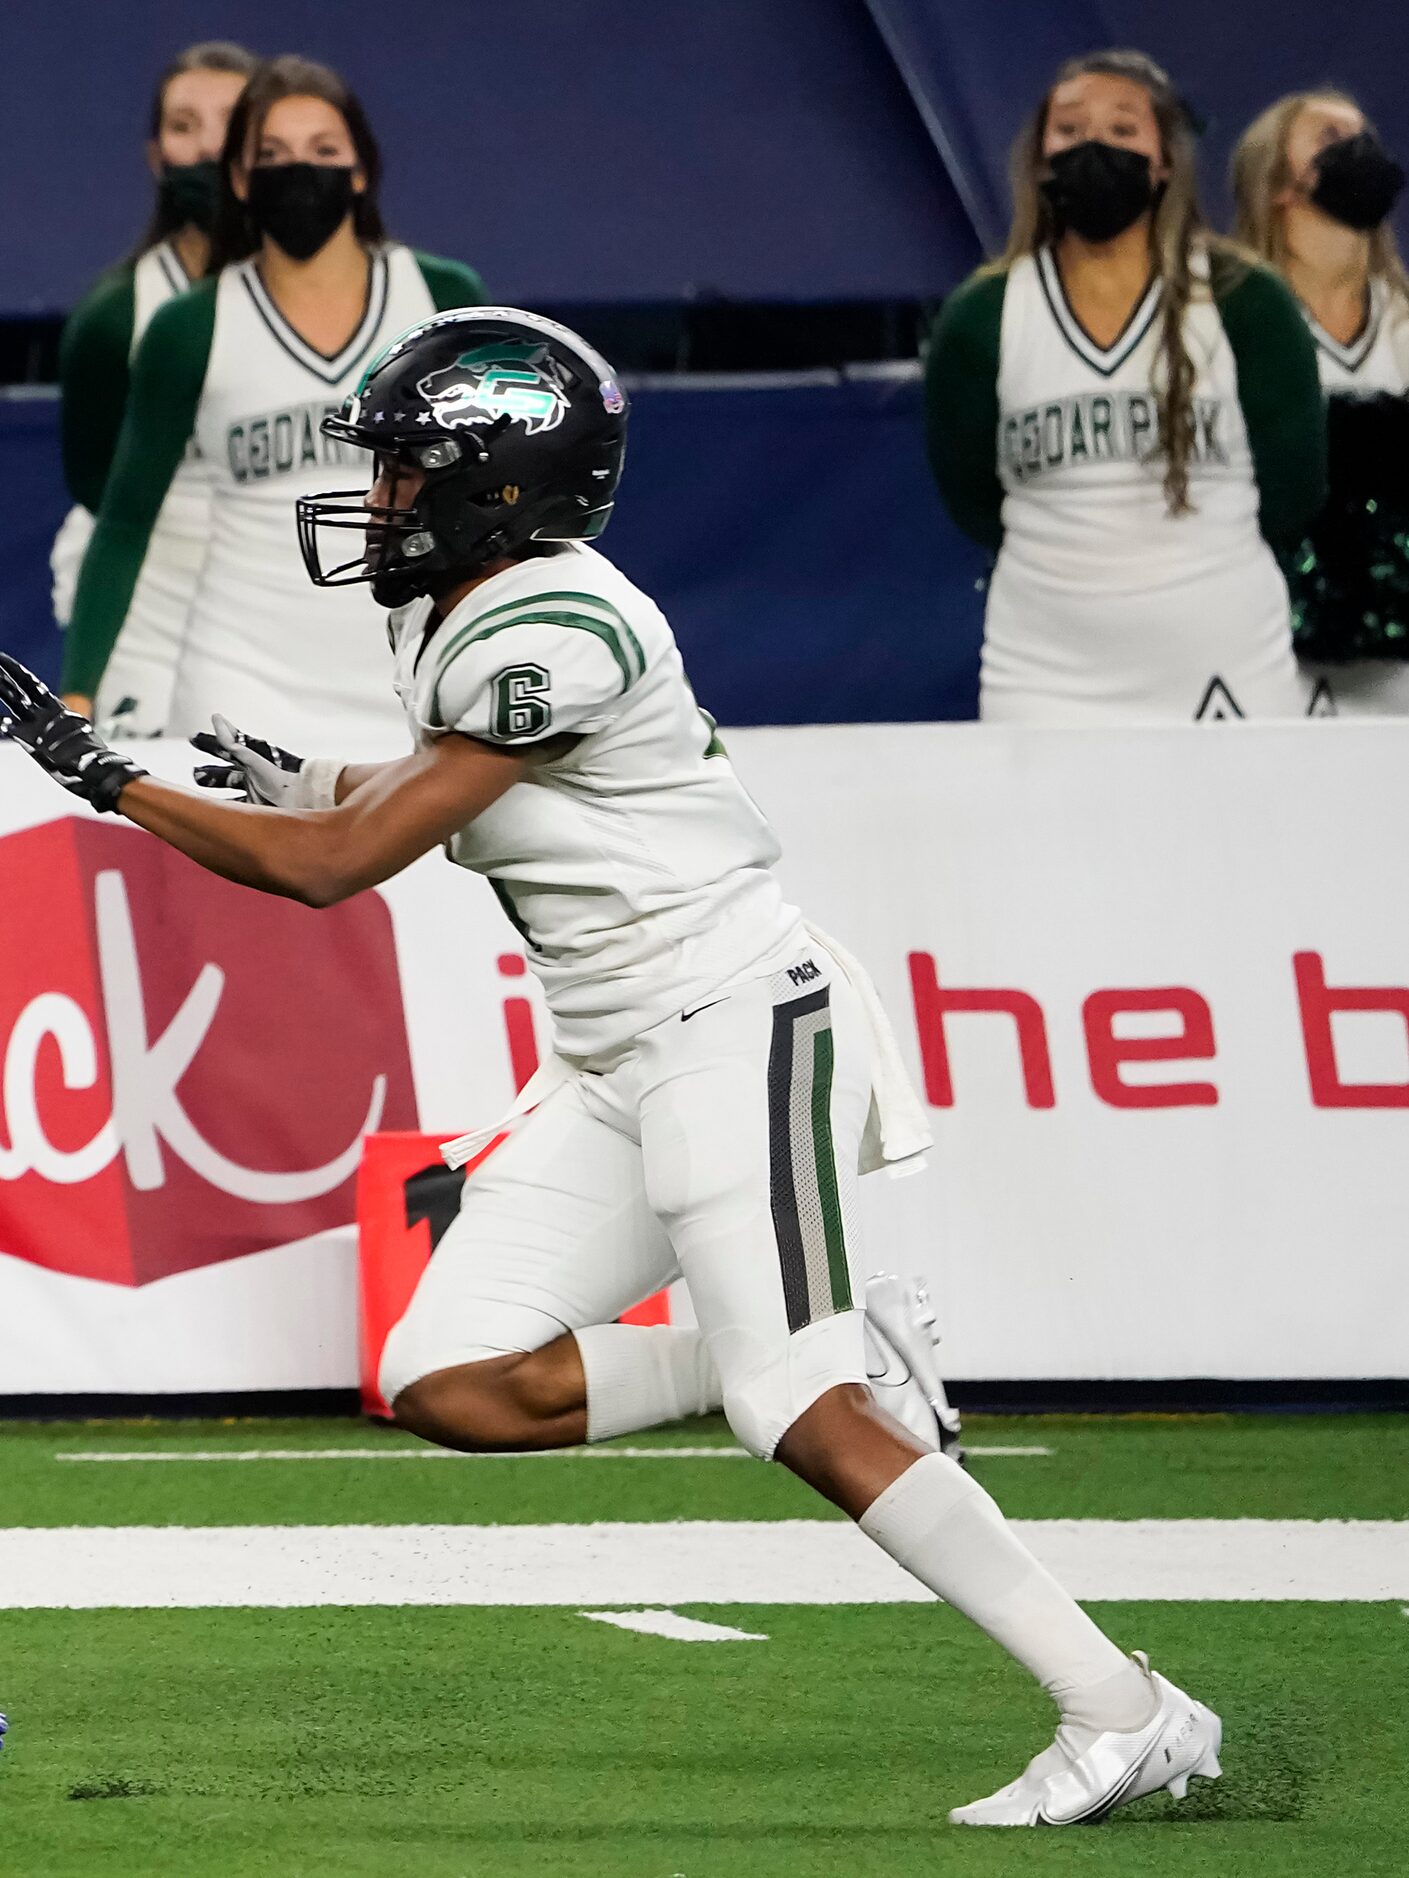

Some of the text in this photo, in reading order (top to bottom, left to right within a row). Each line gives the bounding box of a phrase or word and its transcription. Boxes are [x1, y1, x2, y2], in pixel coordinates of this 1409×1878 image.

[1000, 394, 1114, 486] CEDAR
[489, 662, 552, 738] 6
[786, 958, 823, 987] PACK
[906, 950, 1220, 1109] he
